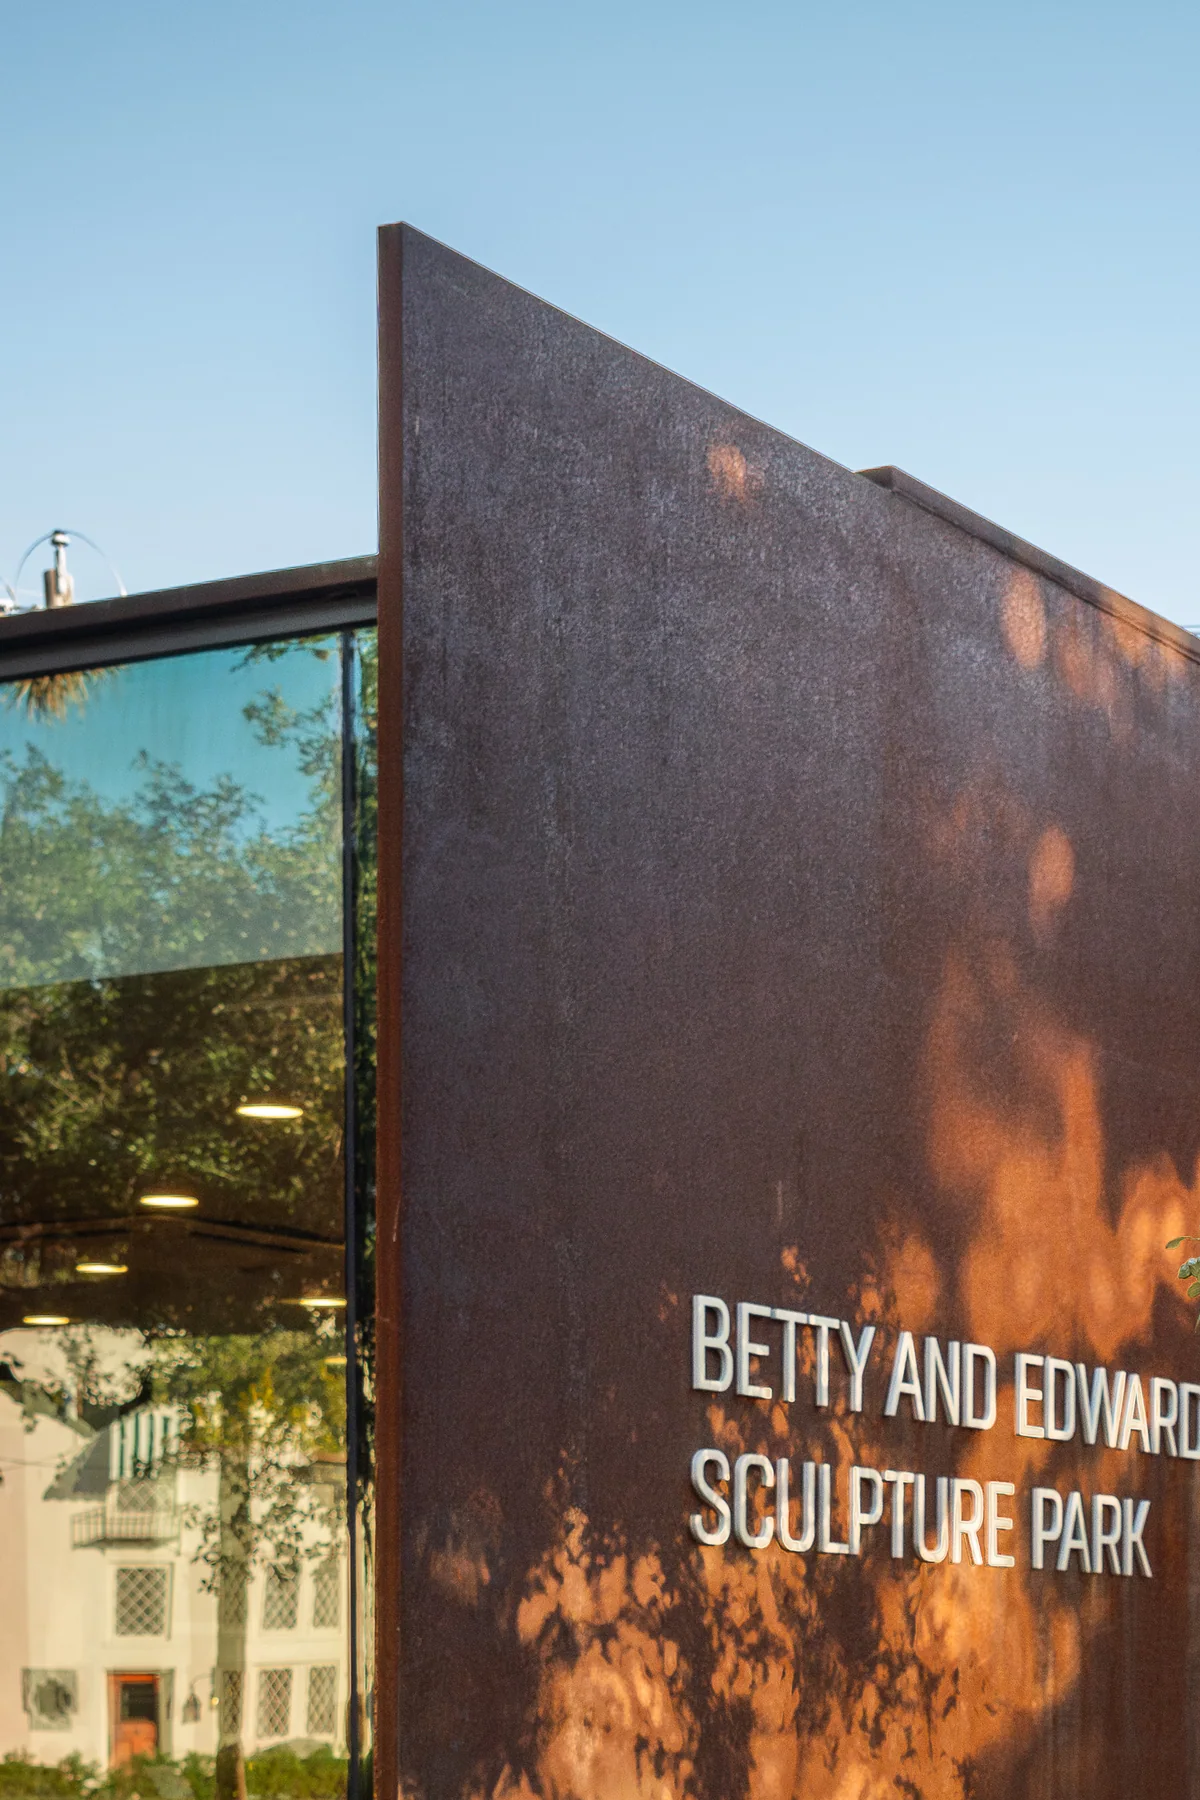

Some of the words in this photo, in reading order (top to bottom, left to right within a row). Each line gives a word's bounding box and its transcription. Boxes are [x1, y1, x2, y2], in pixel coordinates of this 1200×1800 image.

[692, 1294, 876, 1412] BETTY
[885, 1331, 996, 1431] AND
[690, 1448, 1015, 1568] SCULPTURE
[1032, 1486, 1153, 1578] PARK
